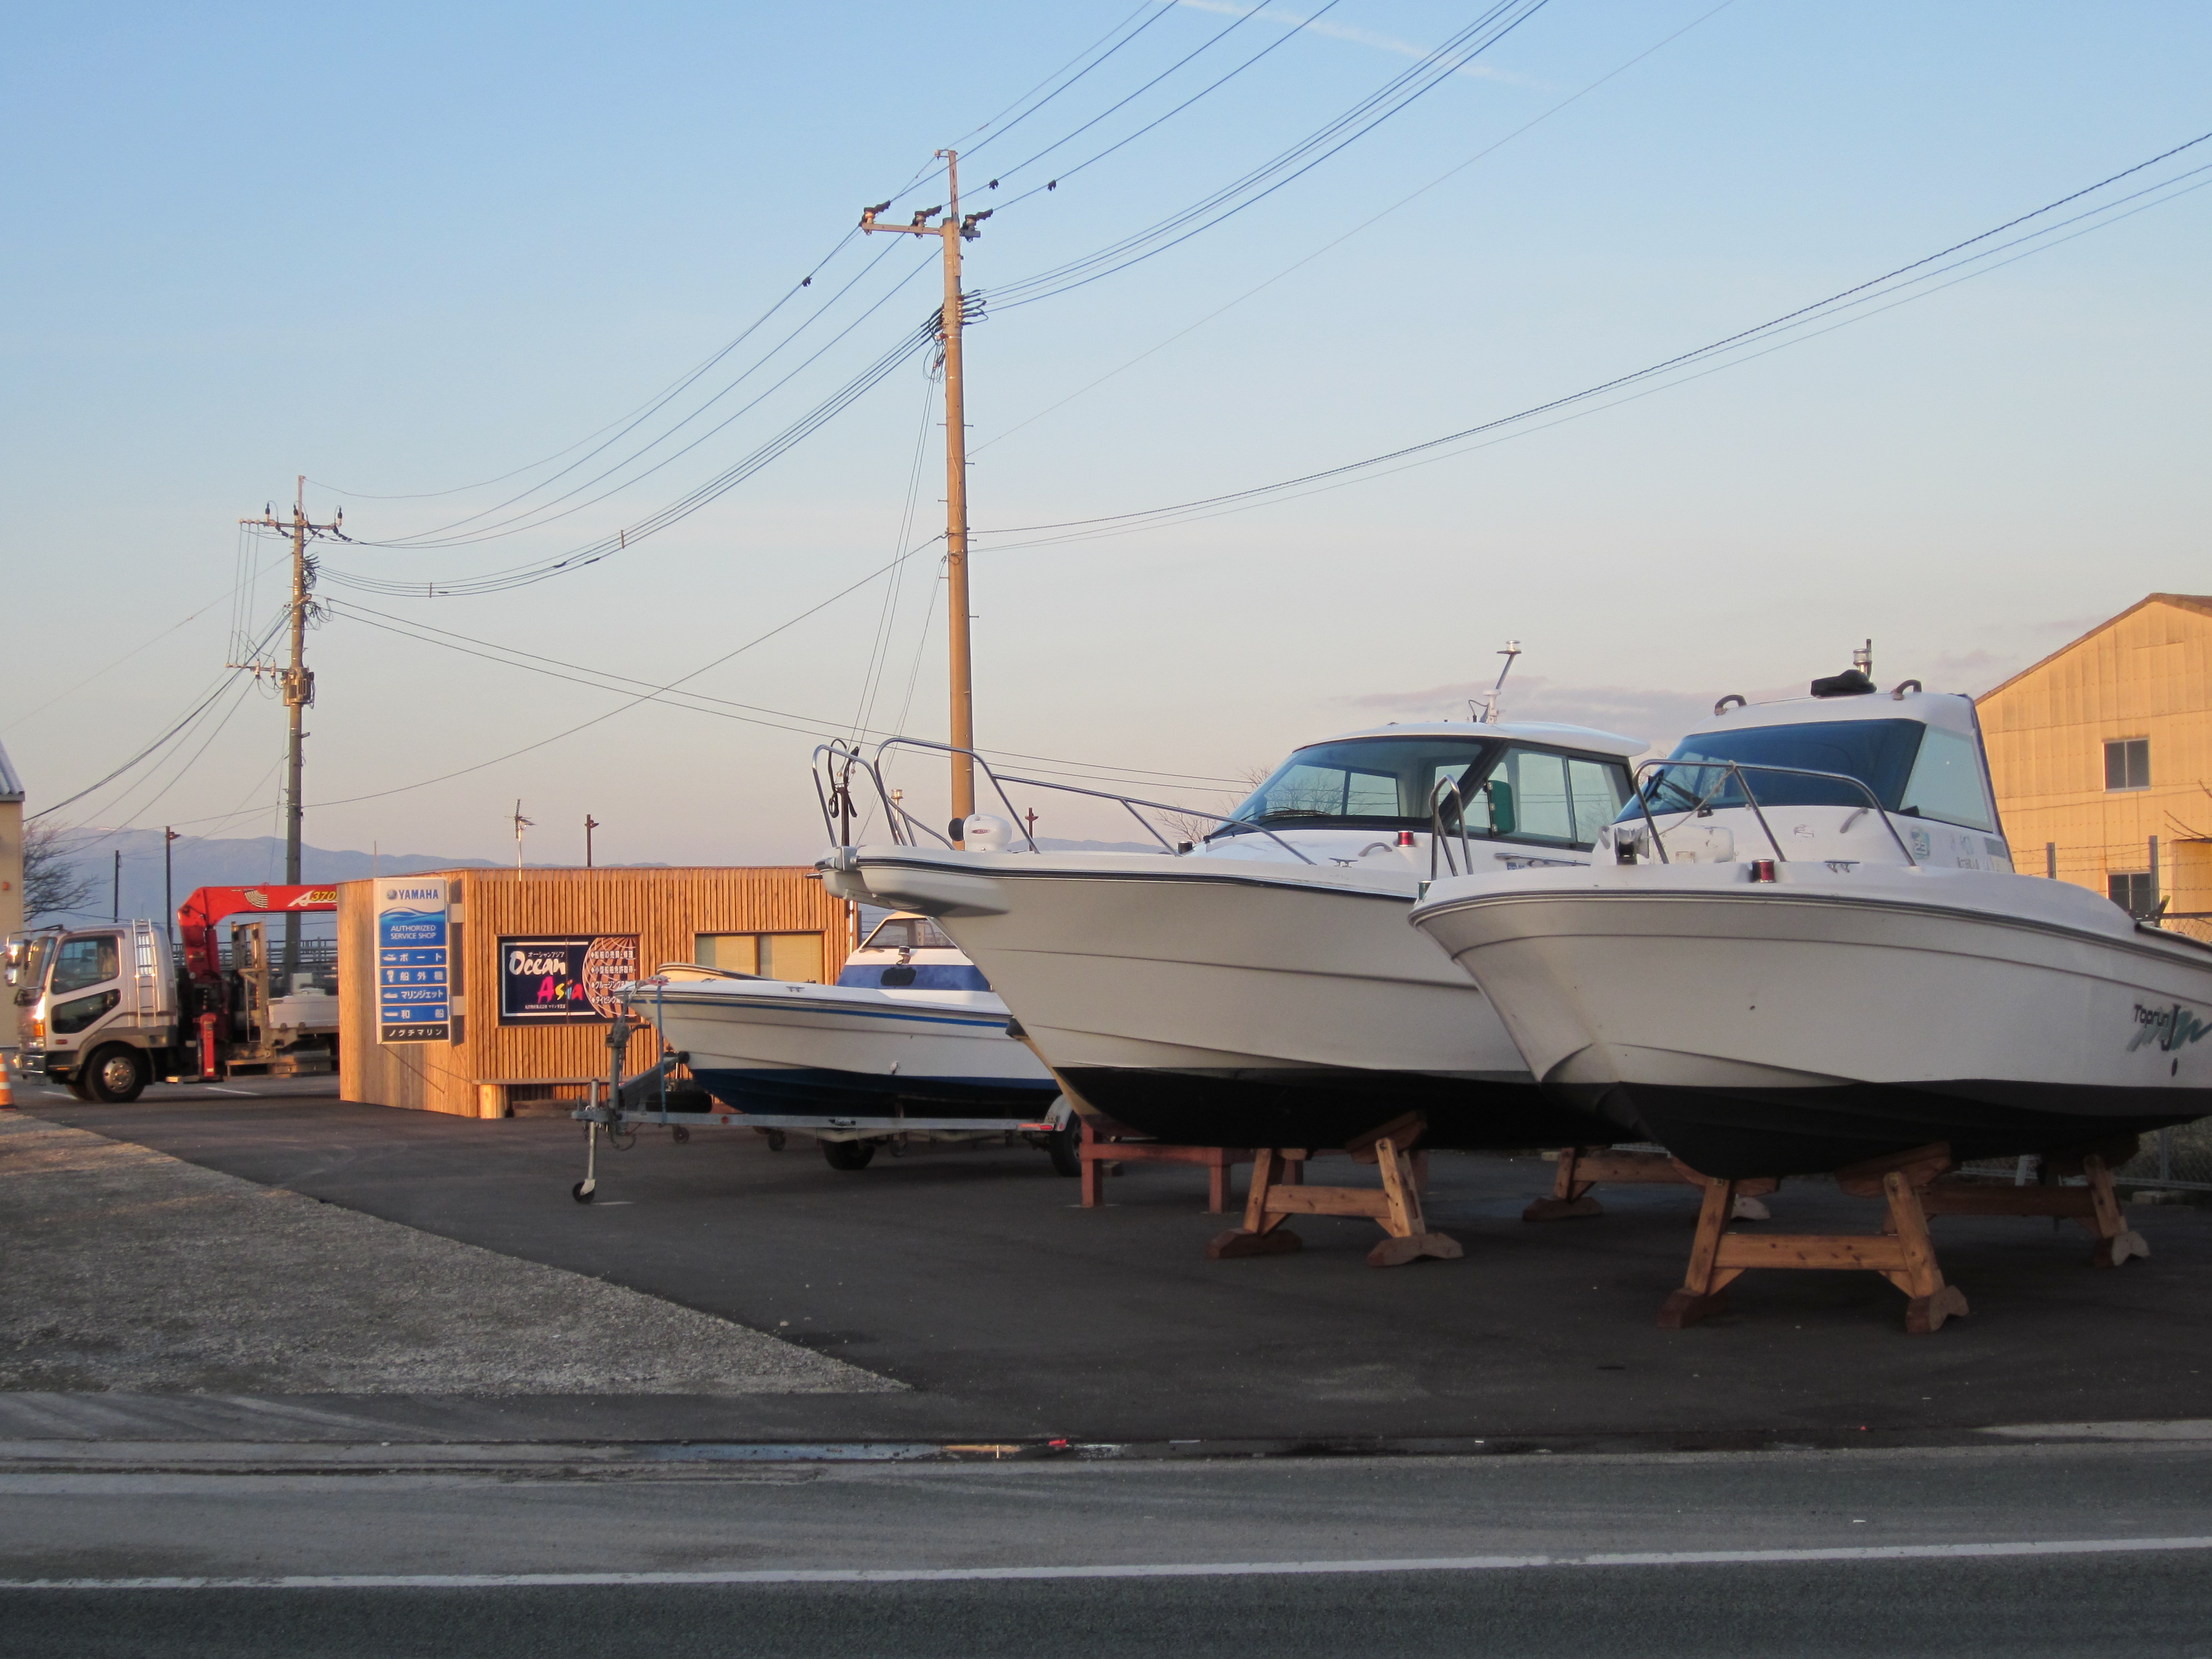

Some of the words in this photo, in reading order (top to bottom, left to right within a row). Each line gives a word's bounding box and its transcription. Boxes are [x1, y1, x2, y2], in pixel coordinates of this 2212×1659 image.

[399, 889, 439, 900] YAMAHA
[509, 951, 566, 975] Ocean
[401, 989, 444, 999] マリンジェット
[537, 976, 583, 1004] Asia
